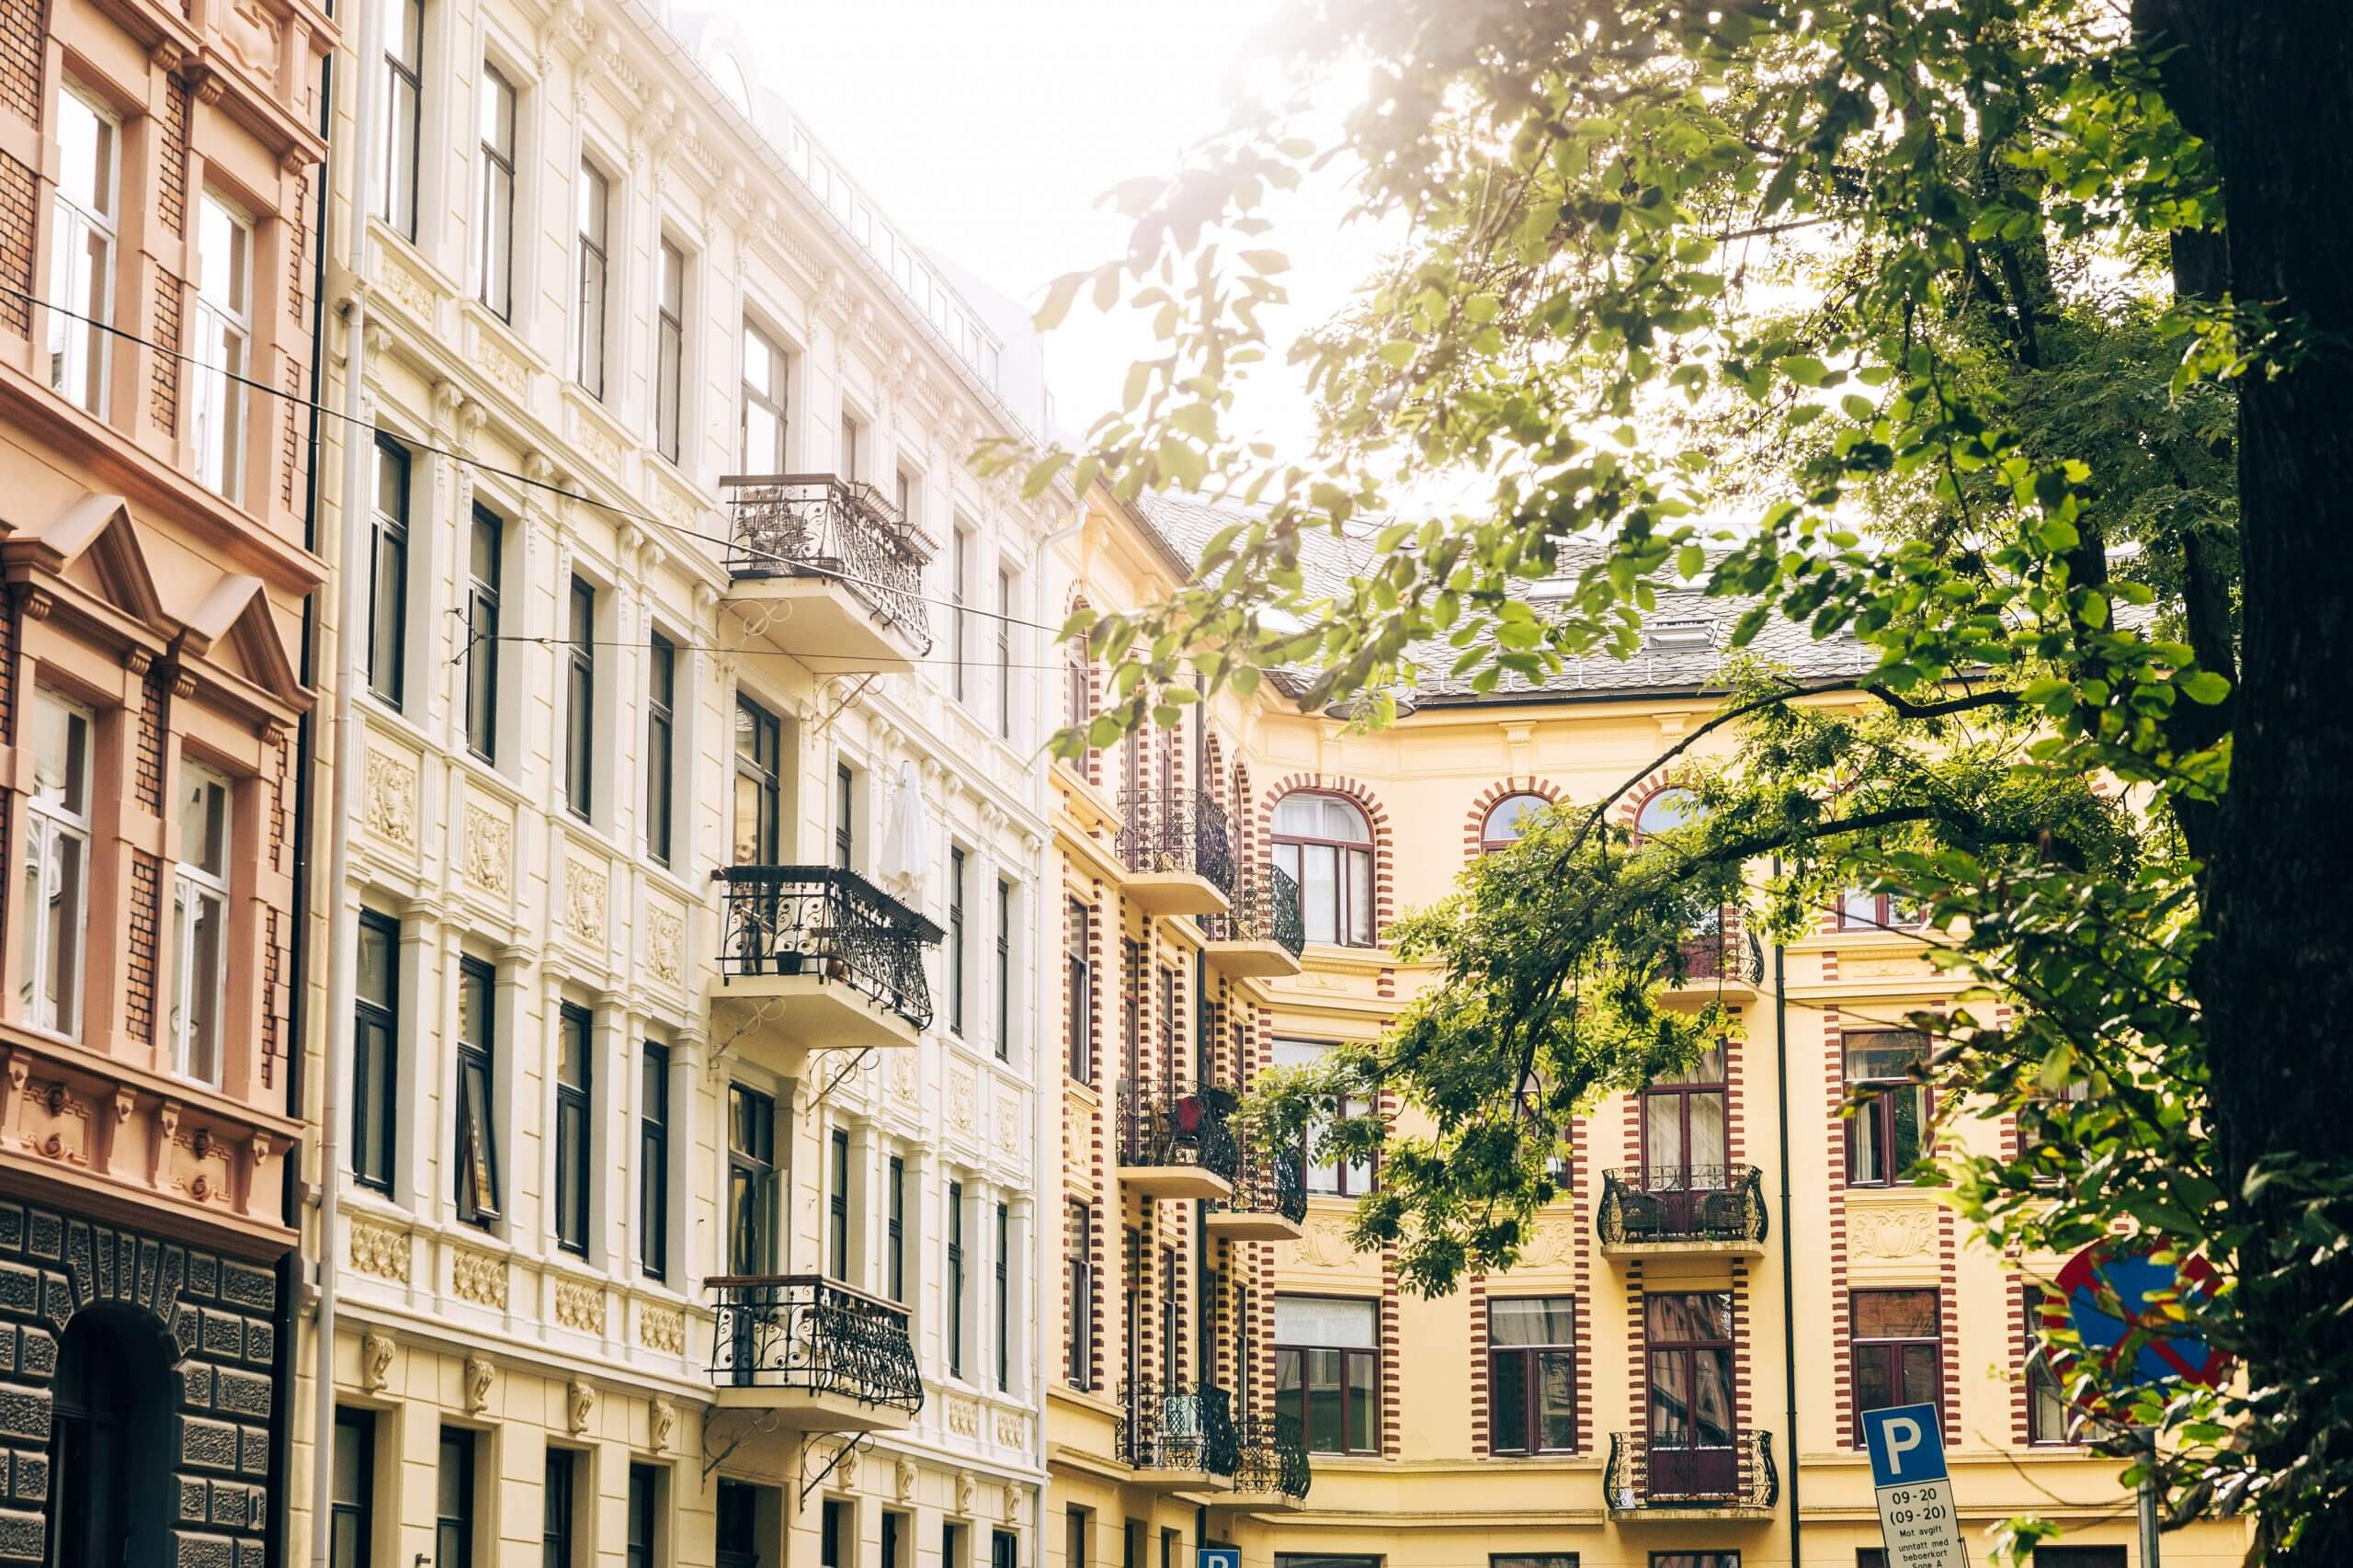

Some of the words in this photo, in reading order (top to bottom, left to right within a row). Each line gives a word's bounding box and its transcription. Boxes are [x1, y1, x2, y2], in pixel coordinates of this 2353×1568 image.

[1882, 1417, 1922, 1475] P
[1900, 1528, 1915, 1537] Mot
[1919, 1526, 1942, 1536] avgift
[1899, 1542, 1928, 1551] unntatt
[1932, 1539, 1949, 1547] med
[1904, 1550, 1948, 1562] beboerkort
